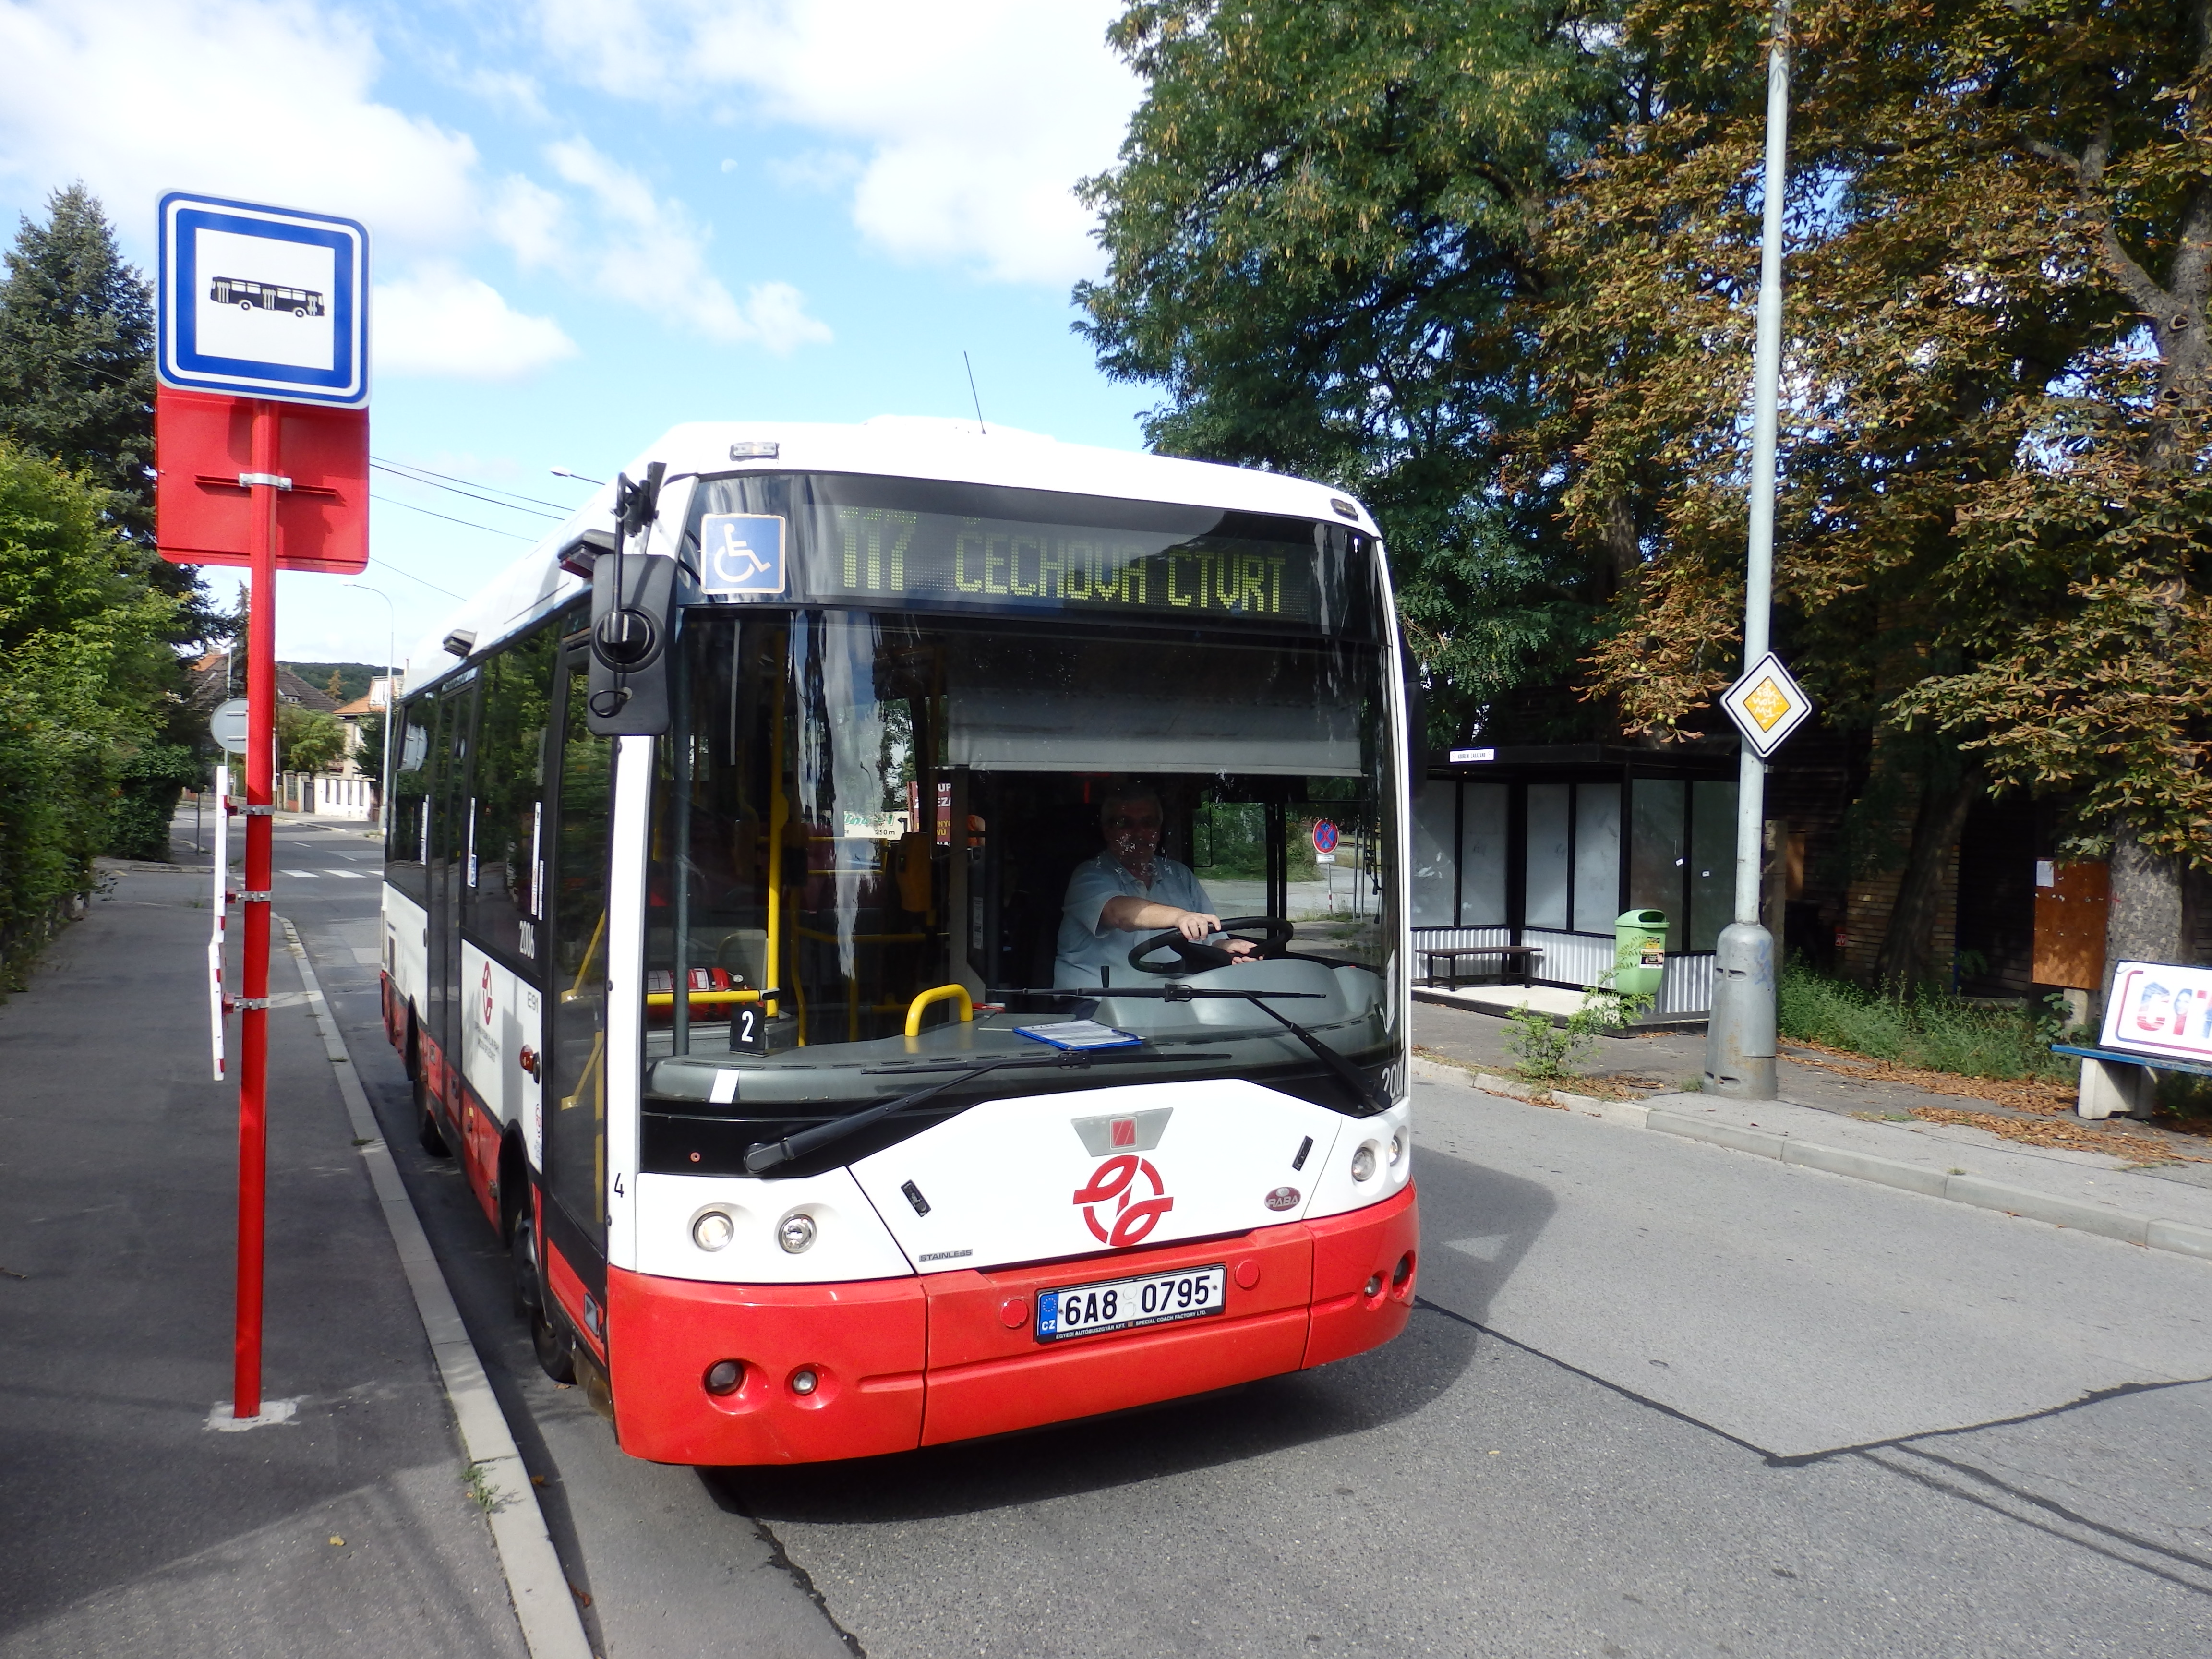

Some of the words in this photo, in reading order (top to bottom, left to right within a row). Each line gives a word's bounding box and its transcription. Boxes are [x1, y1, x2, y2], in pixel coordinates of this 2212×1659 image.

[839, 507, 917, 591] 117
[519, 920, 535, 960] 2006
[741, 1010, 754, 1042] 2
[613, 1173, 625, 1198] 4
[920, 1249, 972, 1262] STAINLESS
[1065, 1290, 1118, 1325] 6A8
[1142, 1275, 1210, 1313] 0795
[1041, 1320, 1056, 1331] CZ
